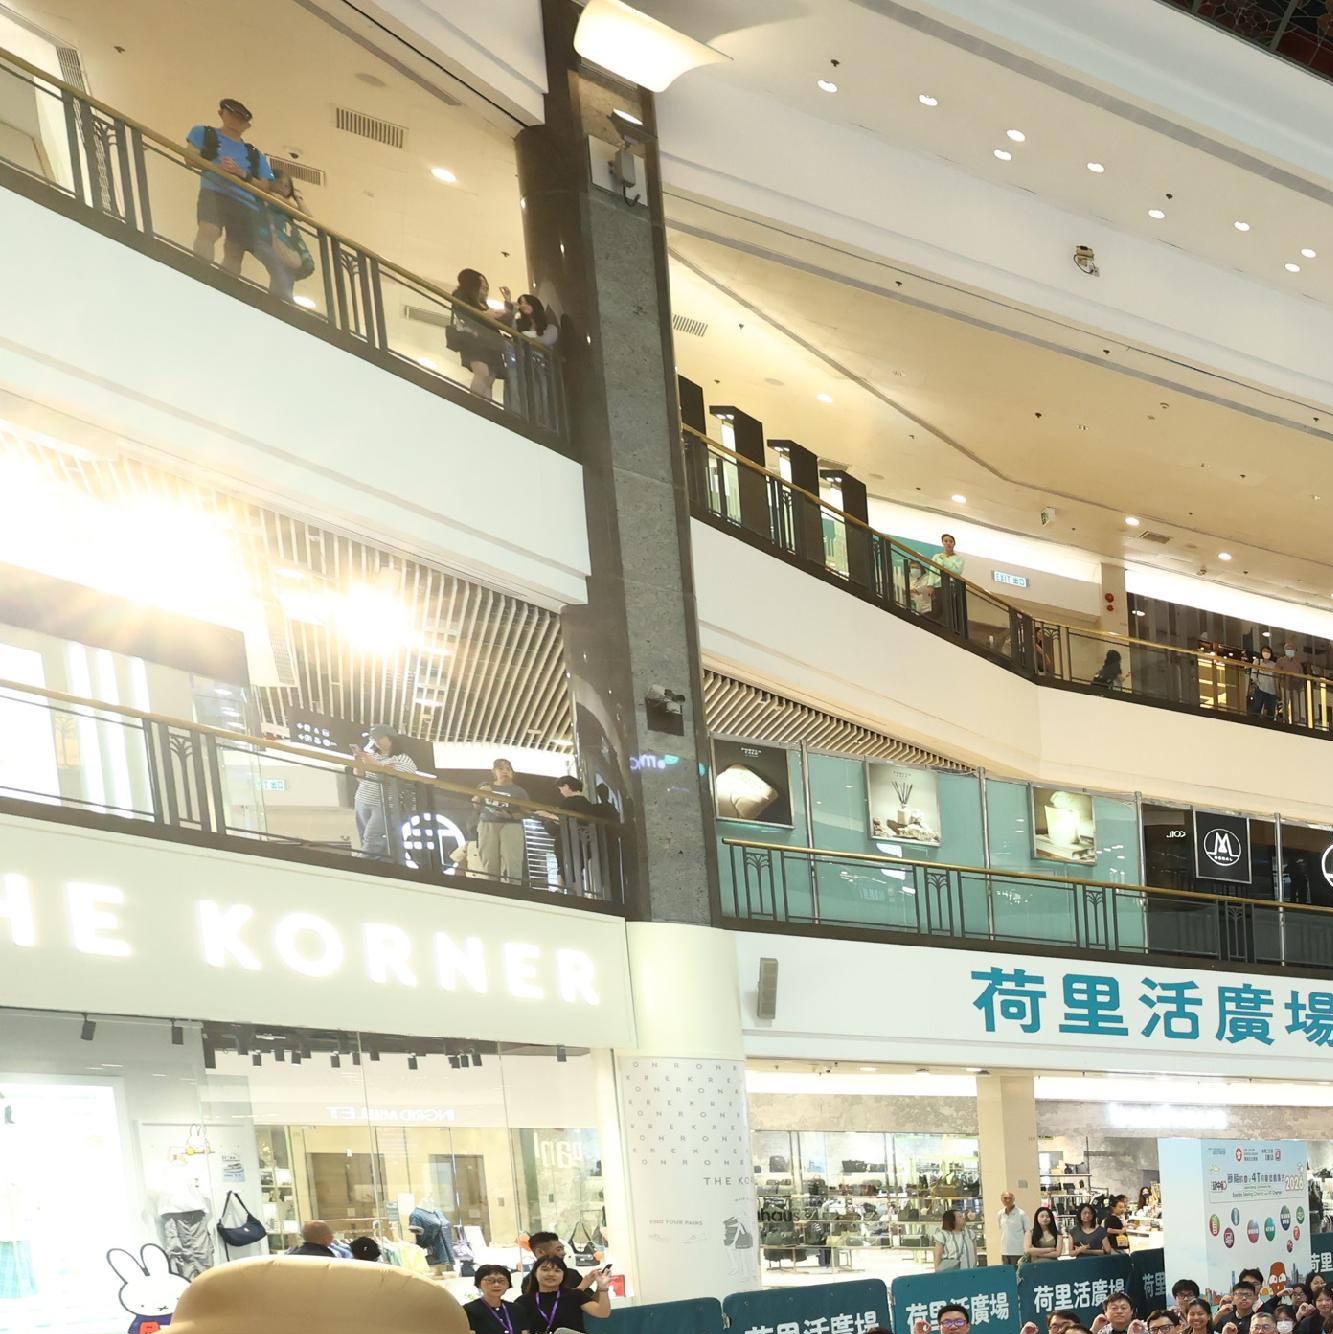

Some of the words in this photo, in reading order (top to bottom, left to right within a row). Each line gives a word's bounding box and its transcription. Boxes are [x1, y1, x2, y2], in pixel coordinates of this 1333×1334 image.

[198, 898, 601, 1005] KORNER
[704, 1176, 732, 1185] THE
[1284, 1175, 1304, 1191] 2026
